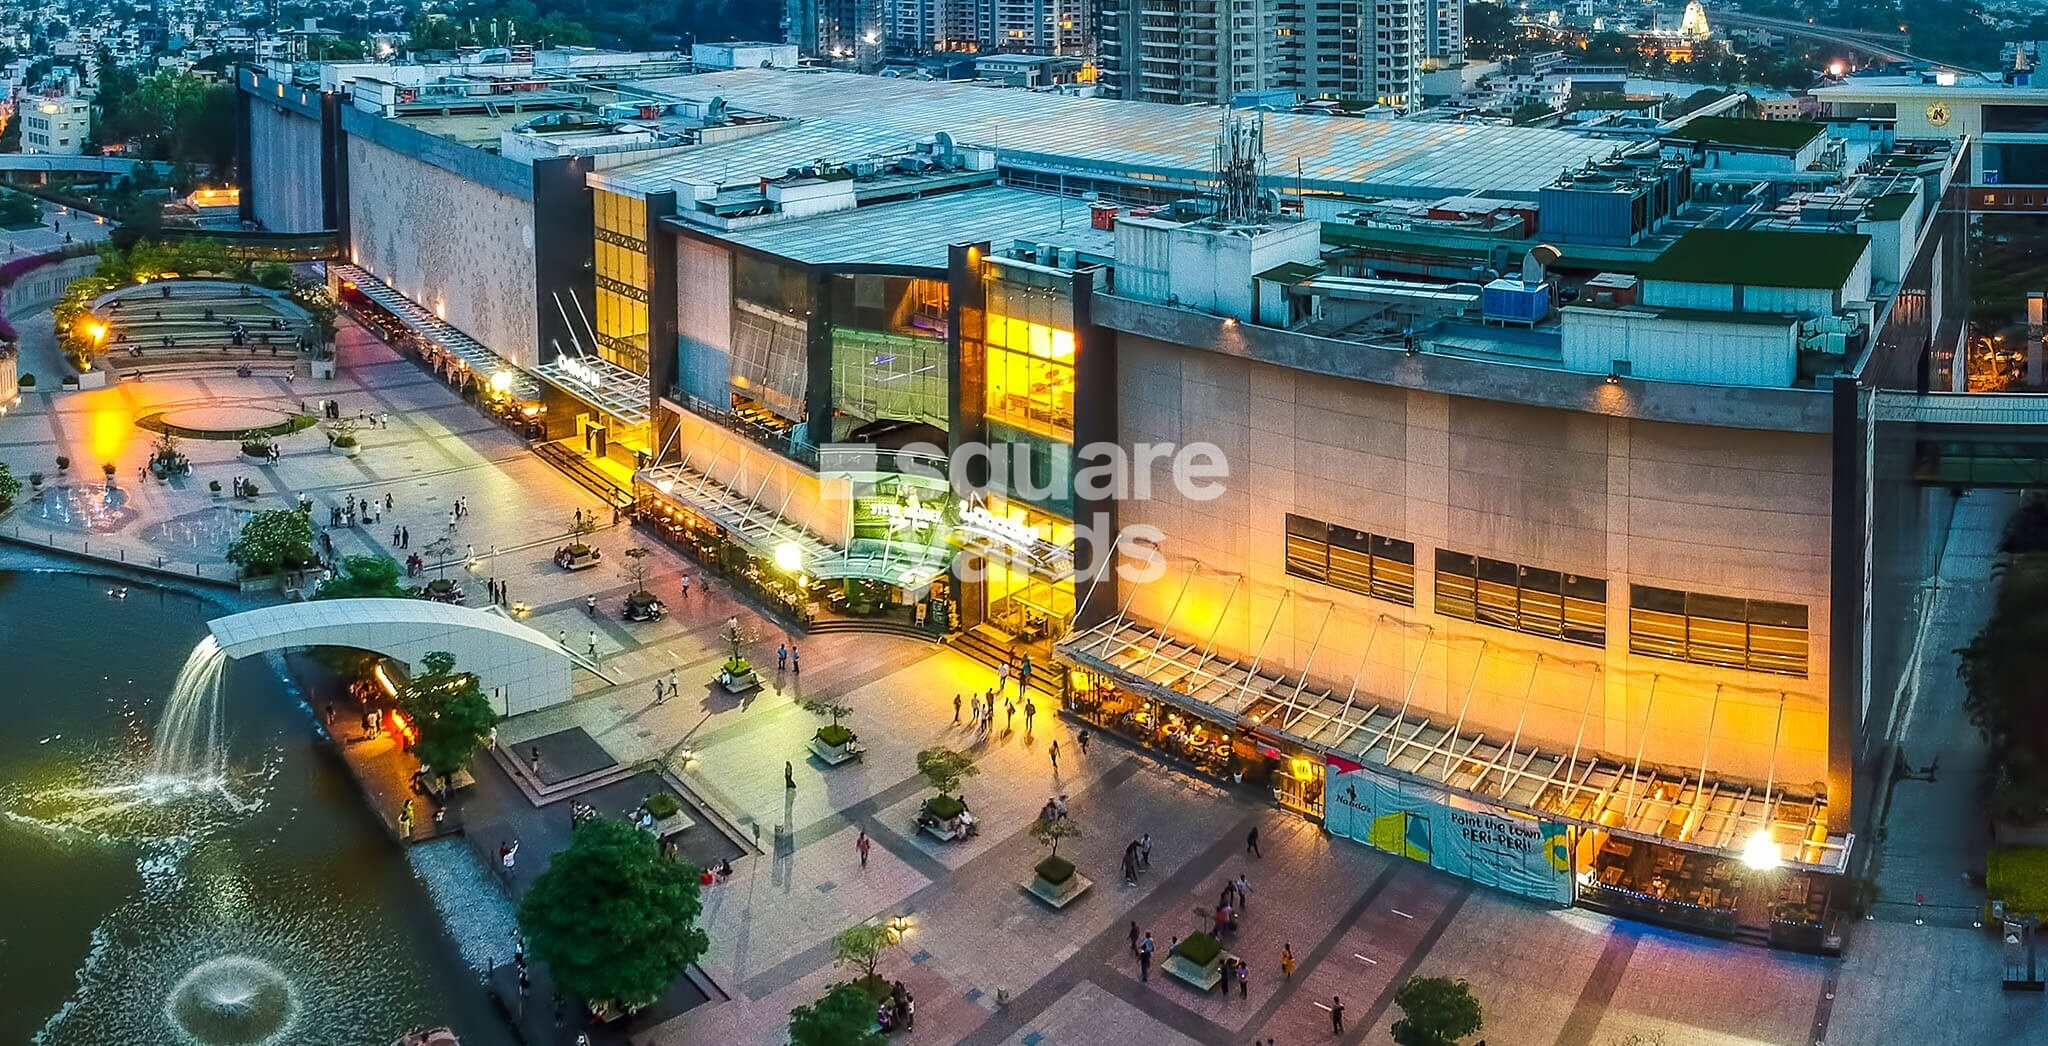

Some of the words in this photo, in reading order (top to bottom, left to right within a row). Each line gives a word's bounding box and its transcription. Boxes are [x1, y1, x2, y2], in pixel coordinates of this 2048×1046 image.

[1451, 812, 1483, 828] Paint
[1485, 818, 1506, 832] the
[1509, 823, 1541, 840] town
